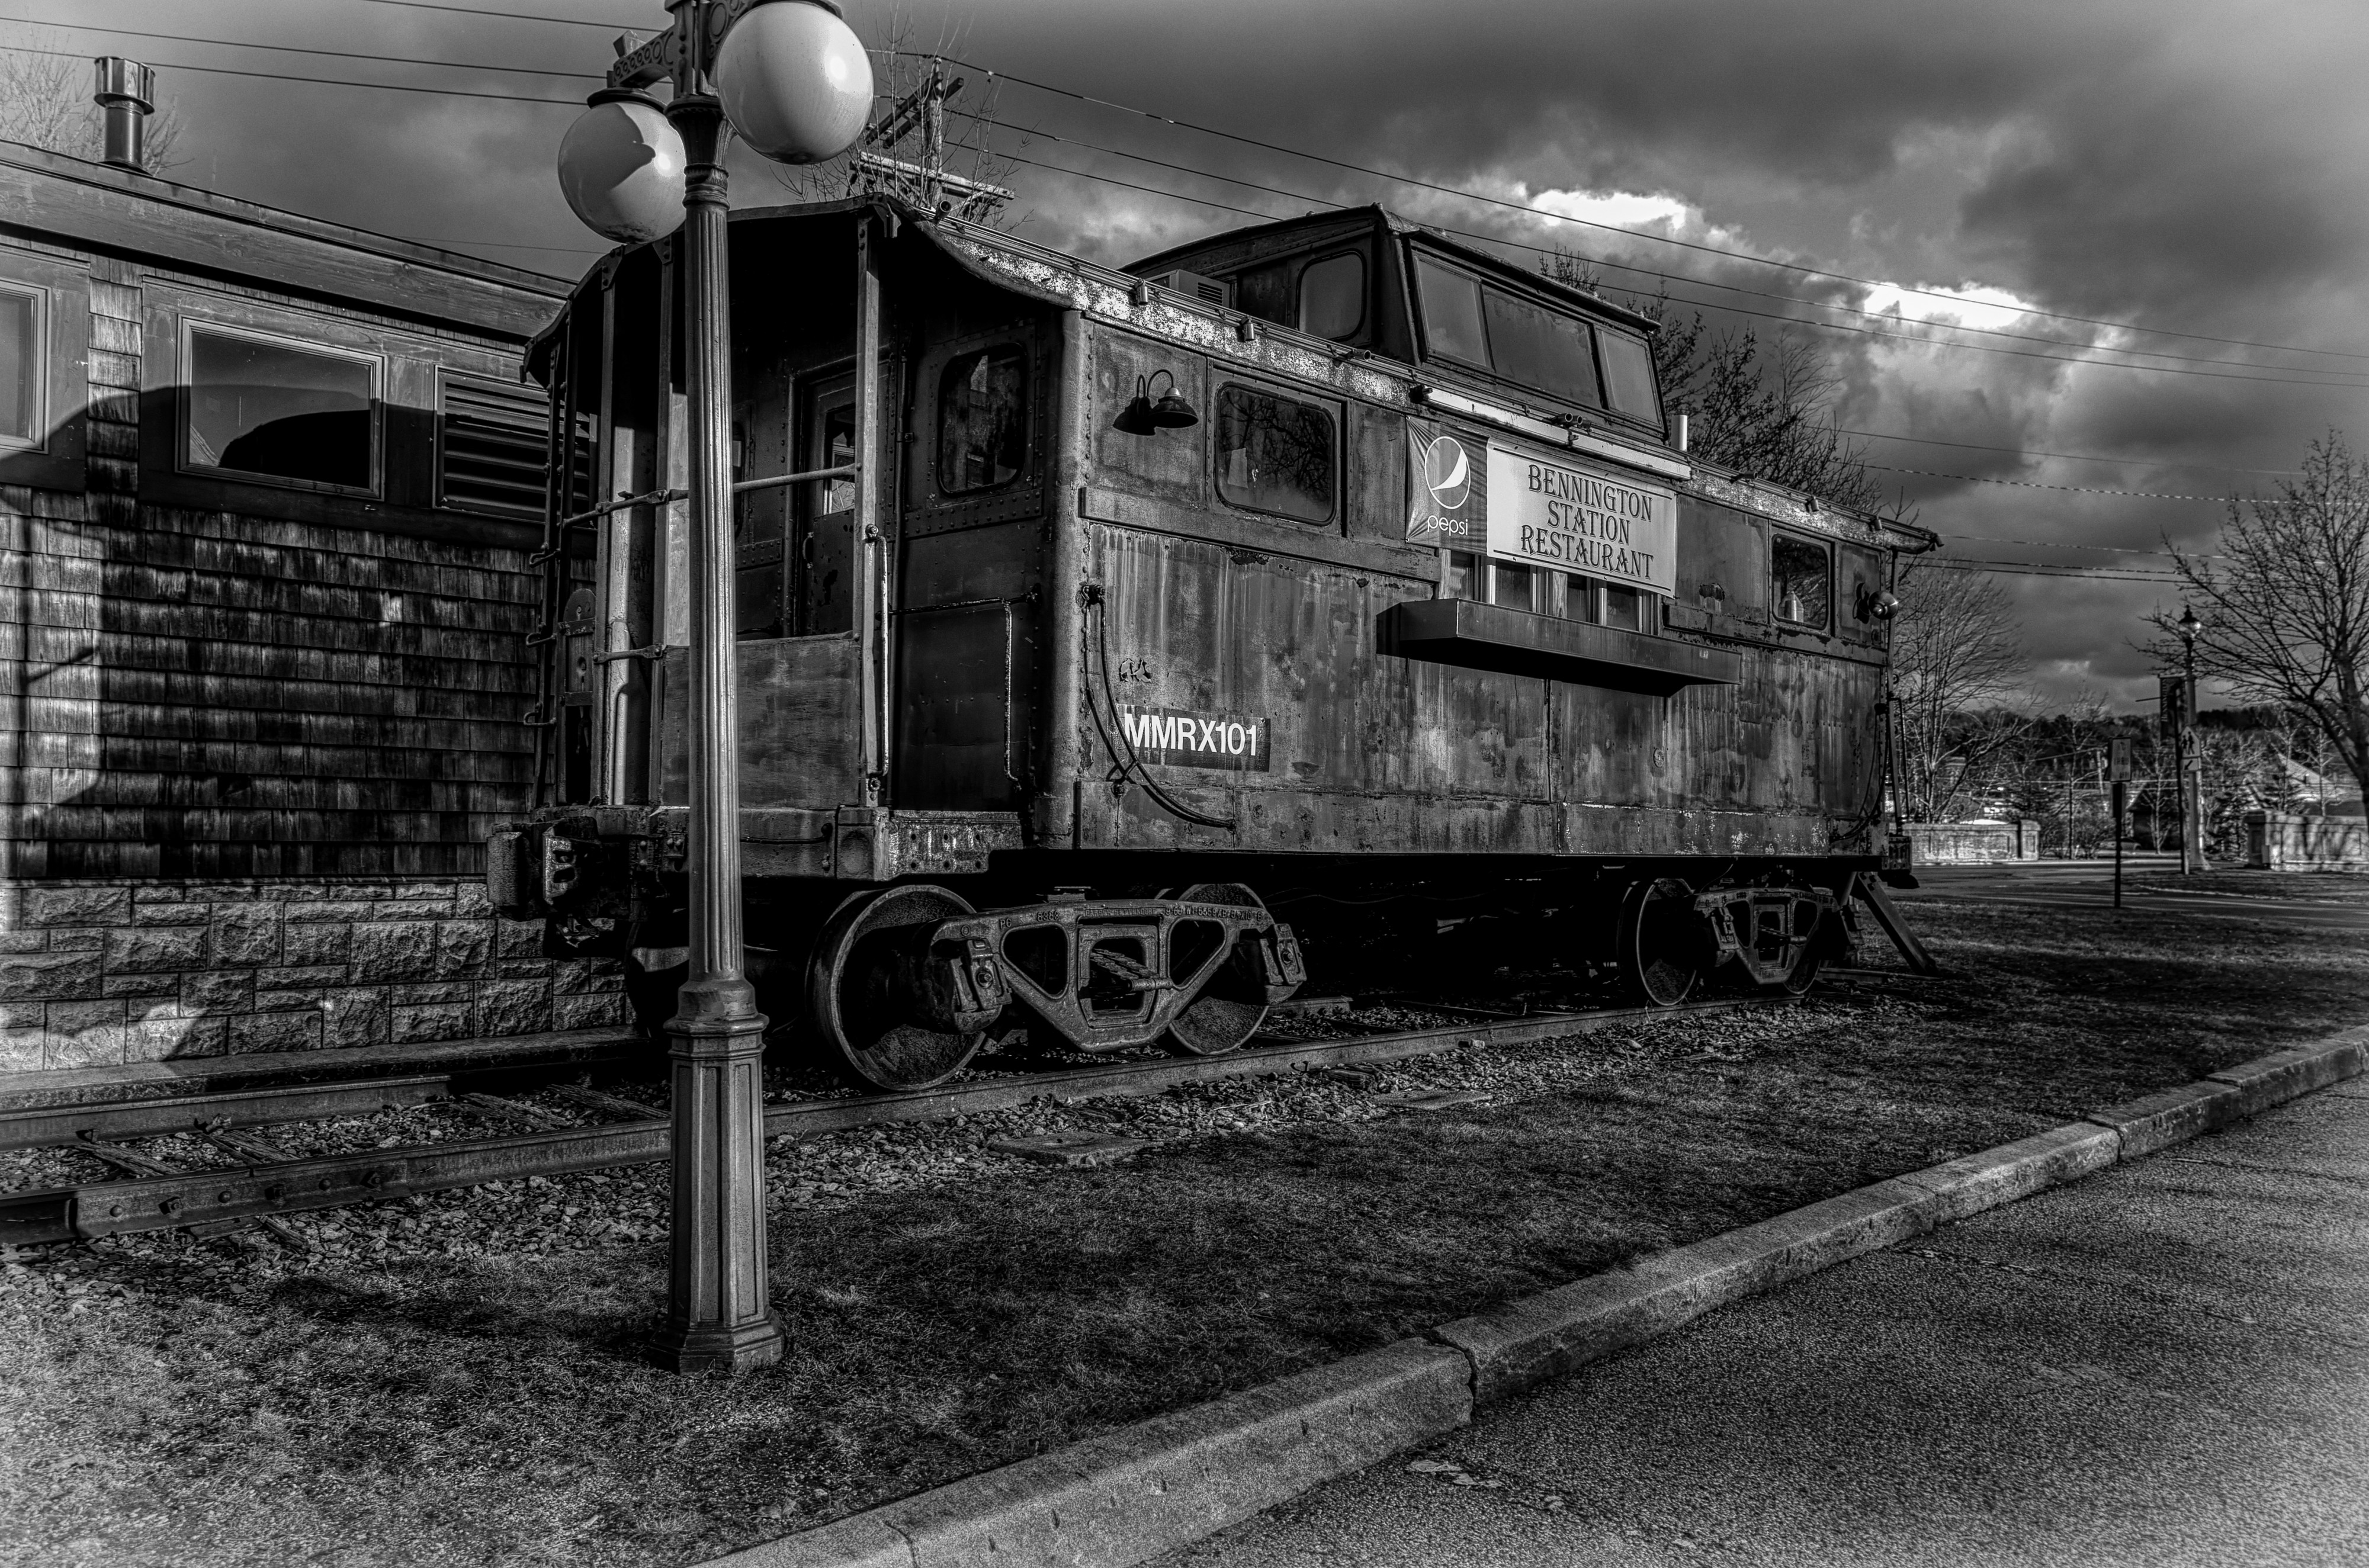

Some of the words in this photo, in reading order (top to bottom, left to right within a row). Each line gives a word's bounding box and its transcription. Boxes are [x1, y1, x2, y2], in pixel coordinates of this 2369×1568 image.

[1528, 464, 1654, 522] BENNINGTON
[1427, 514, 1468, 536] pepsi
[1547, 500, 1631, 545] STATION
[1521, 524, 1654, 580] RESTAURANT
[1125, 712, 1257, 756] MMRX101
